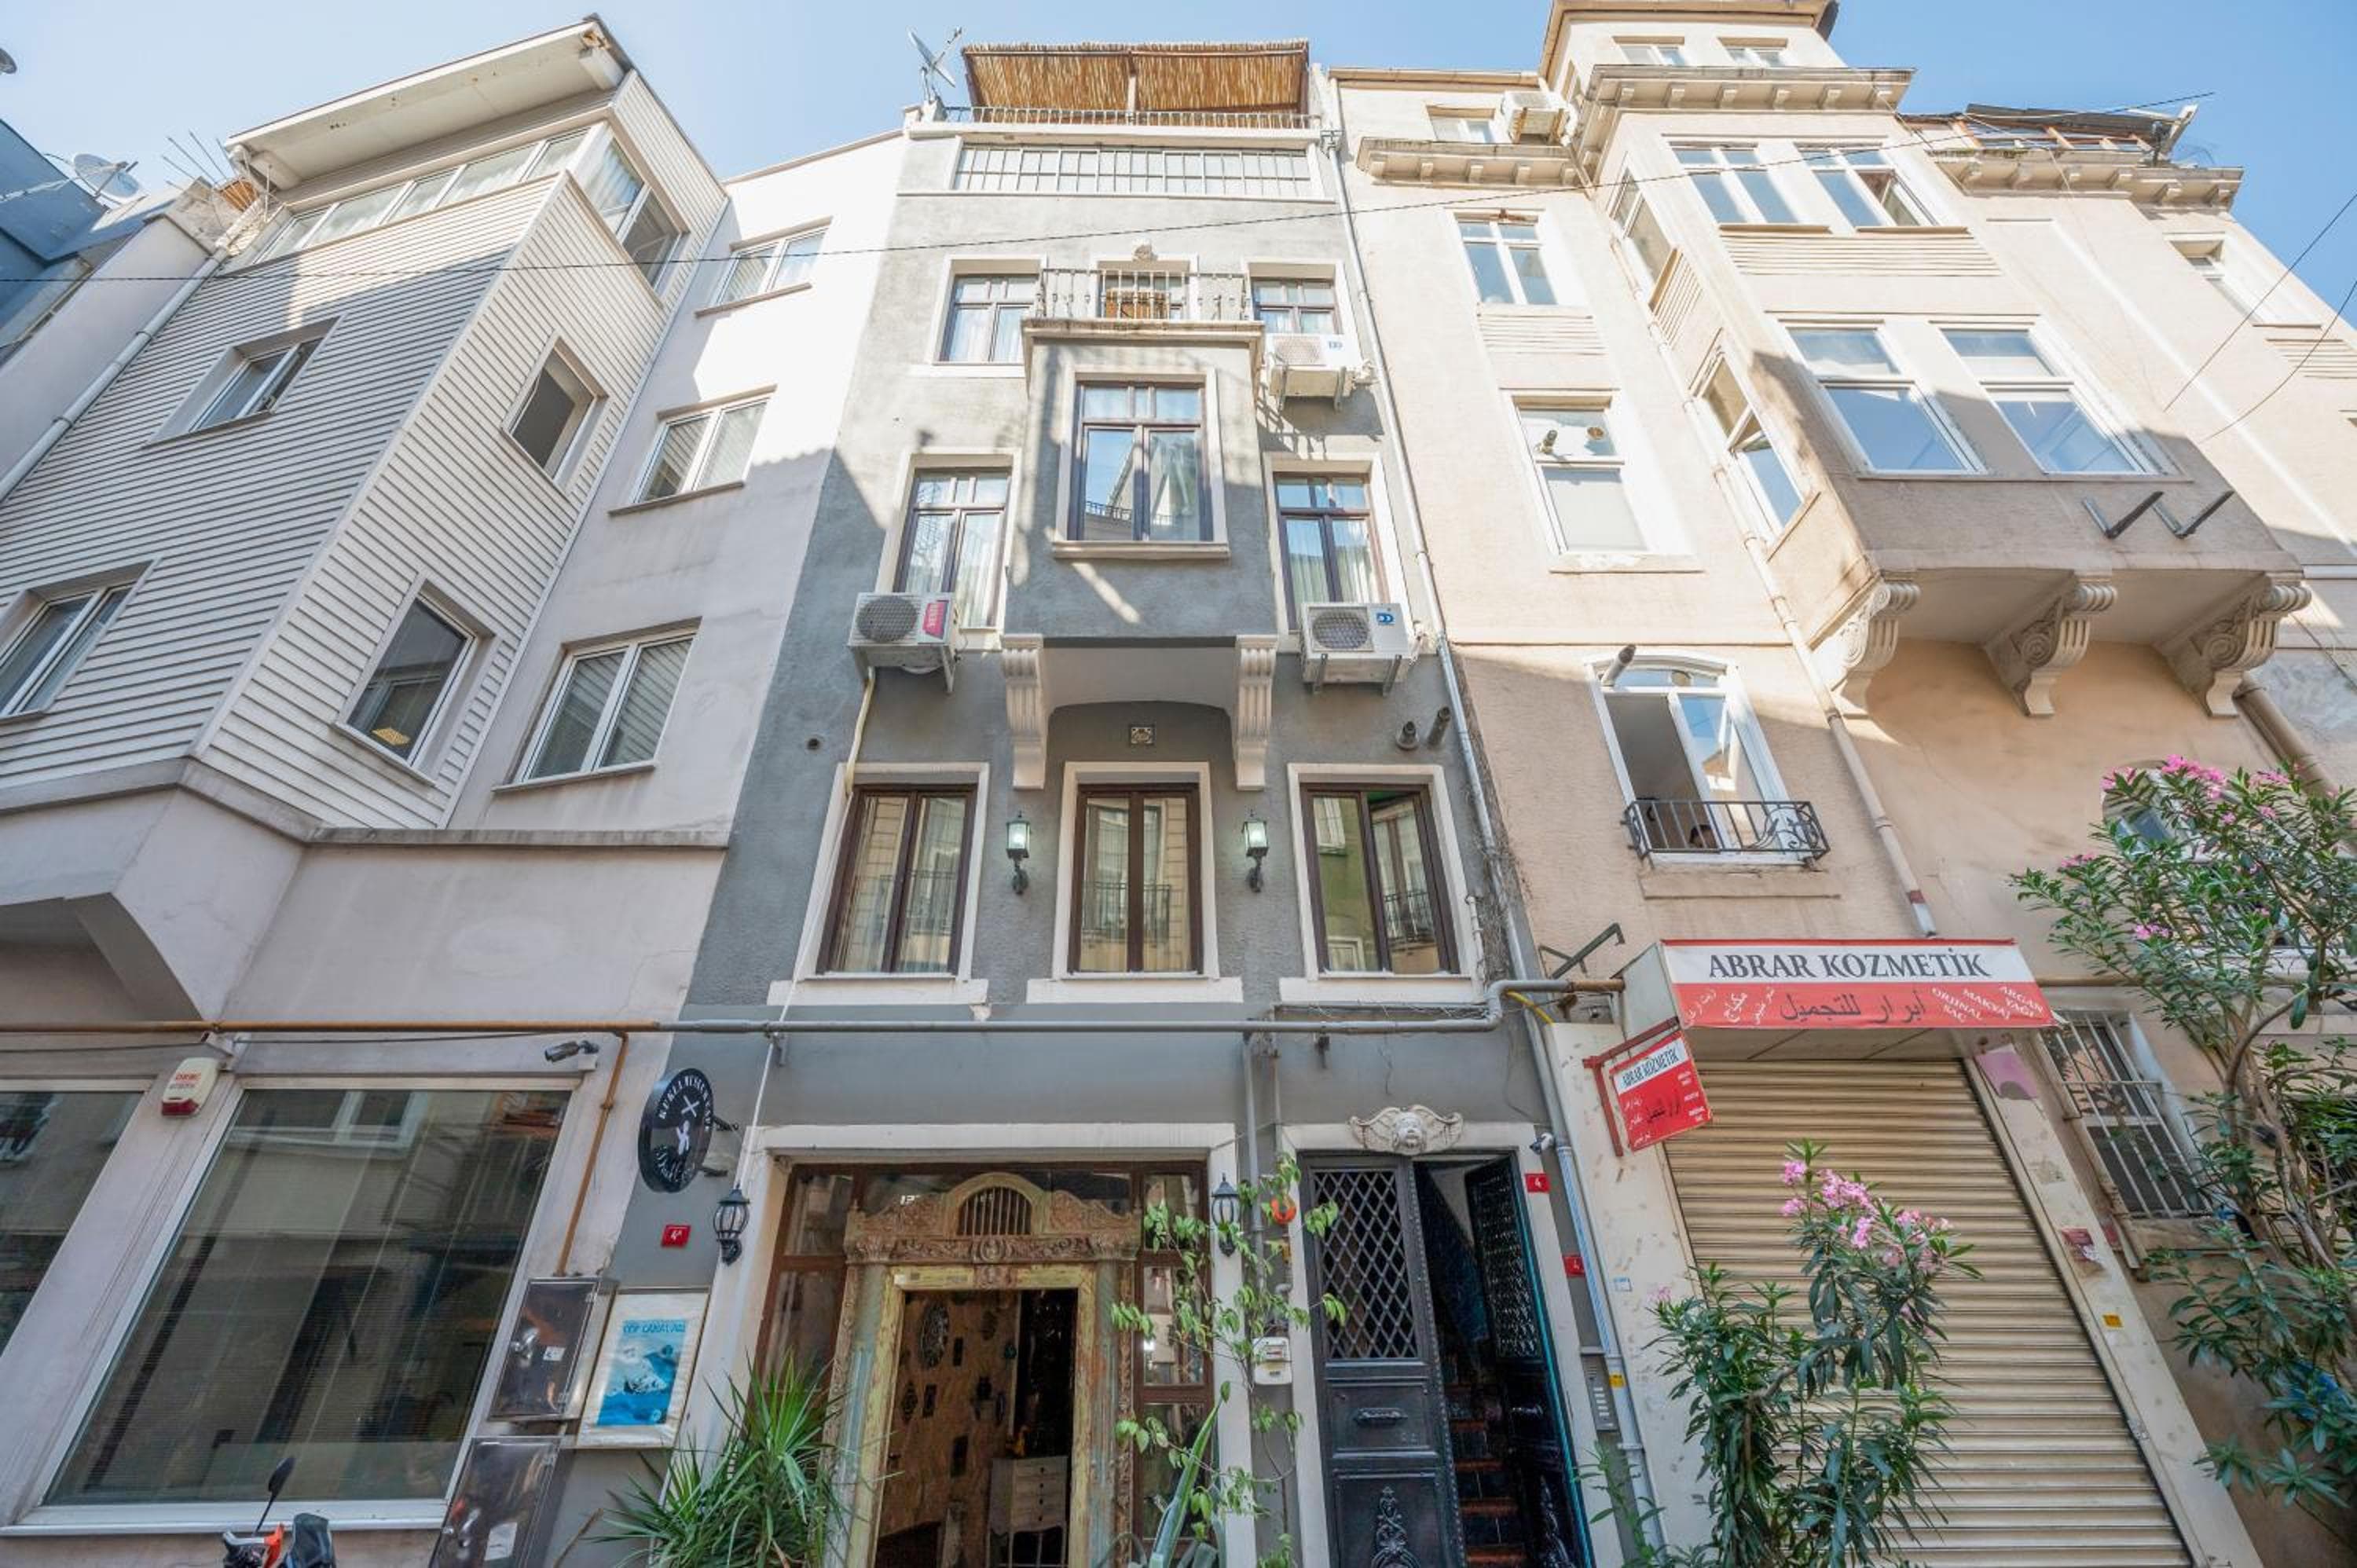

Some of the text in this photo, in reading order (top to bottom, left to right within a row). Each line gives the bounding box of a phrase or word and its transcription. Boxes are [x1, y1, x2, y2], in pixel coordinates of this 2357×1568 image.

[1710, 947, 1992, 978] ABRAR KOZMETİK
[1780, 993, 1861, 1022] للتجميل
